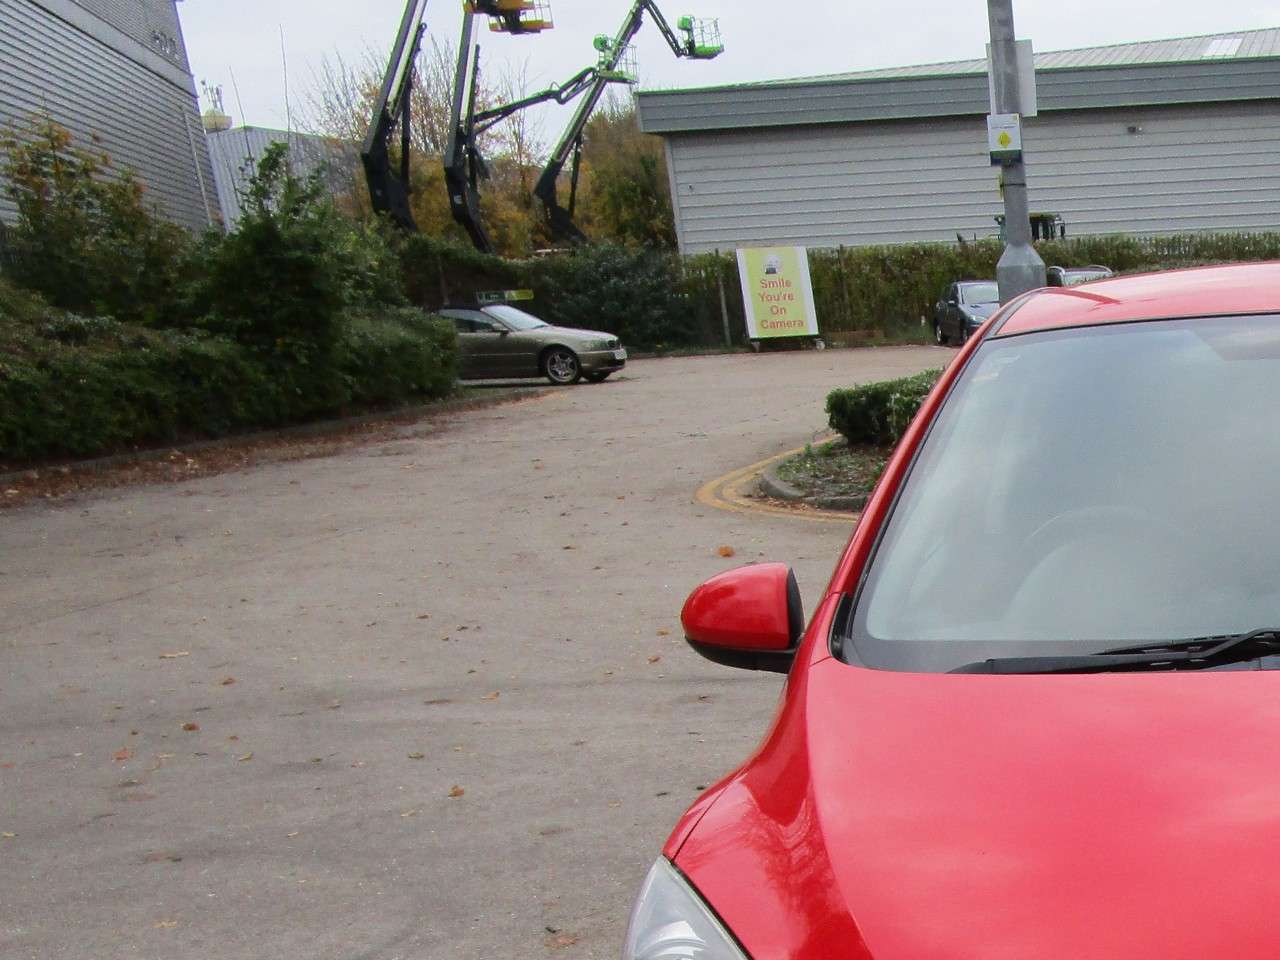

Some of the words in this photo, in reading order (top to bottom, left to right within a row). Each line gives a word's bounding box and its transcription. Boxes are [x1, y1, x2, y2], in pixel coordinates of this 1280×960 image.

[760, 277, 792, 288] Smile
[758, 291, 795, 302] You're
[770, 305, 787, 315] On
[760, 319, 804, 329] Camera
